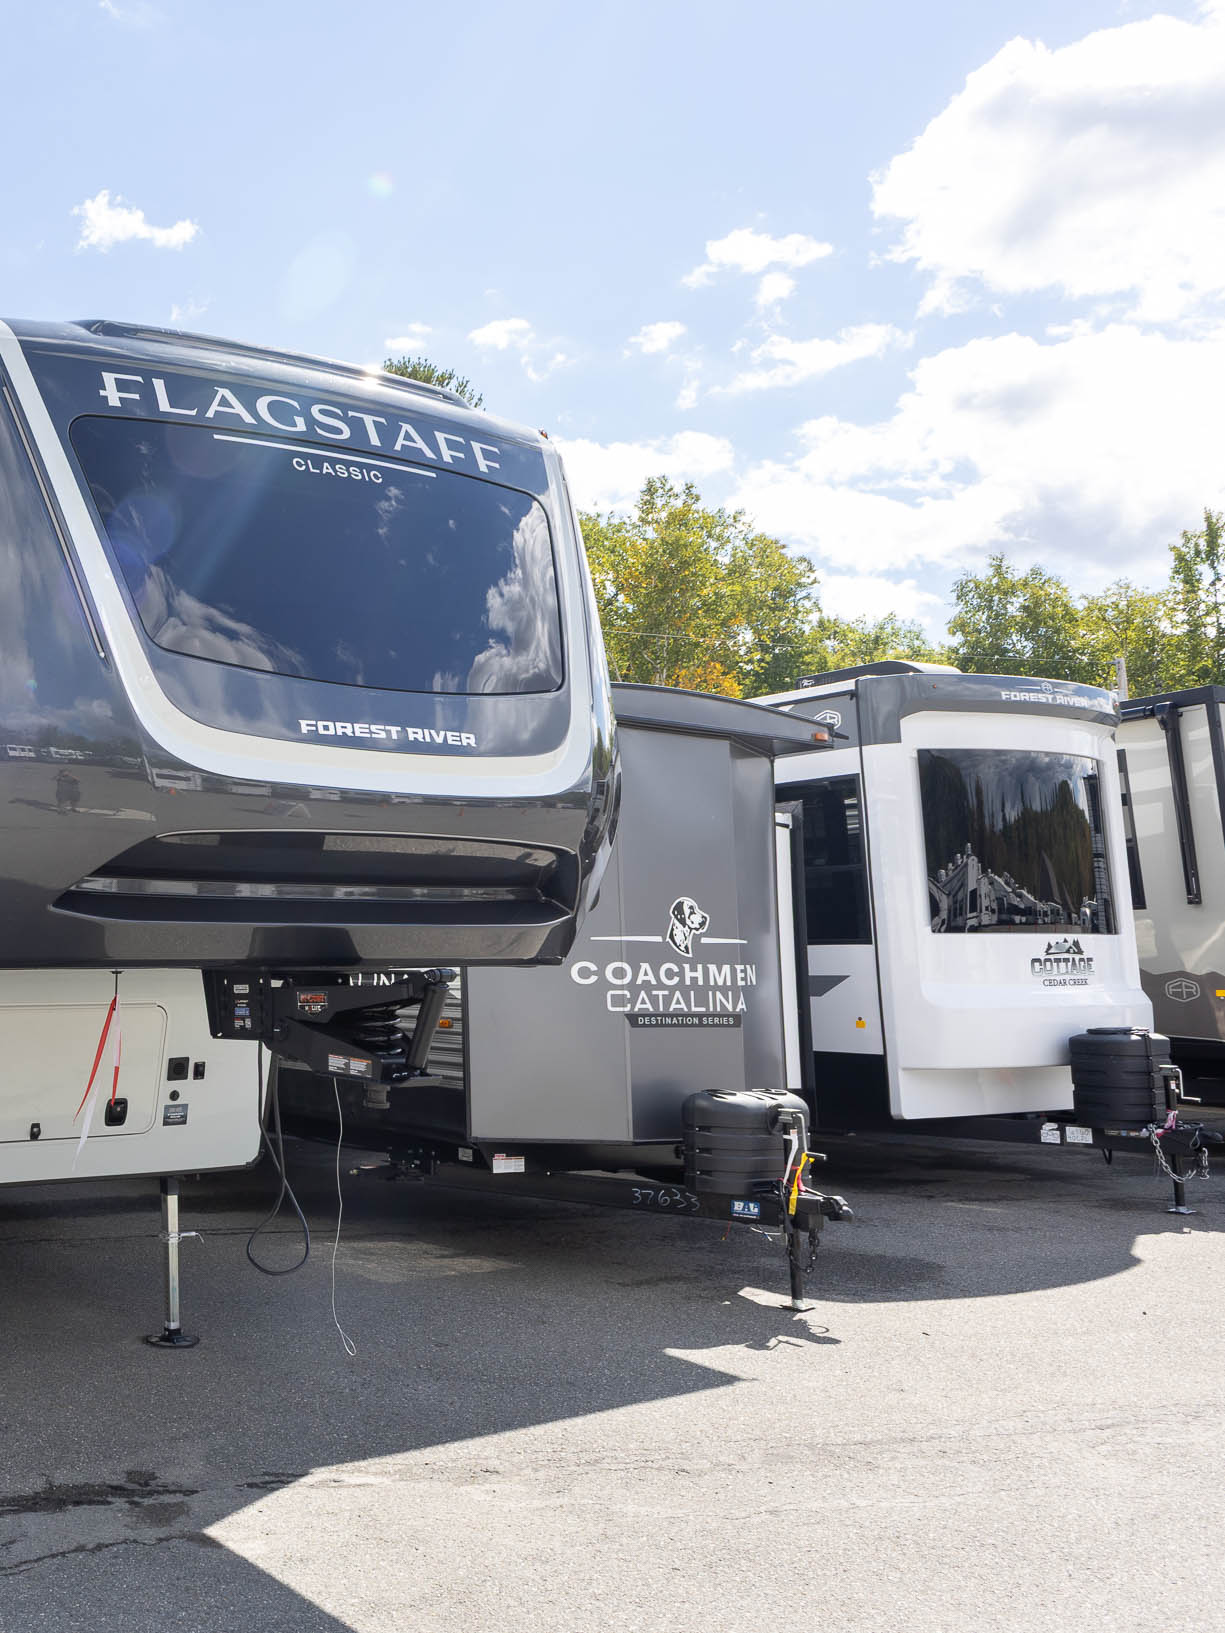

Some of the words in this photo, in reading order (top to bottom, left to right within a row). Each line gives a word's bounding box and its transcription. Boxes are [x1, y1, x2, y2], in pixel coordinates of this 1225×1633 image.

[99, 371, 501, 474] FLAGSTAFF
[292, 457, 383, 484] CLASSIC
[1000, 690, 1054, 704] FOREST
[1056, 694, 1090, 708] RIVER
[298, 719, 401, 740] FOREST
[406, 727, 477, 747] RIVER
[570, 961, 757, 986] COACHMEN
[1030, 957, 1095, 976] COTTAGE
[1042, 978, 1067, 987] CEDAR
[606, 990, 748, 1012] CATALINA
[637, 1016, 699, 1025] DESTINATION
[702, 1016, 735, 1025] SERIES
[631, 1188, 701, 1211] 37633
